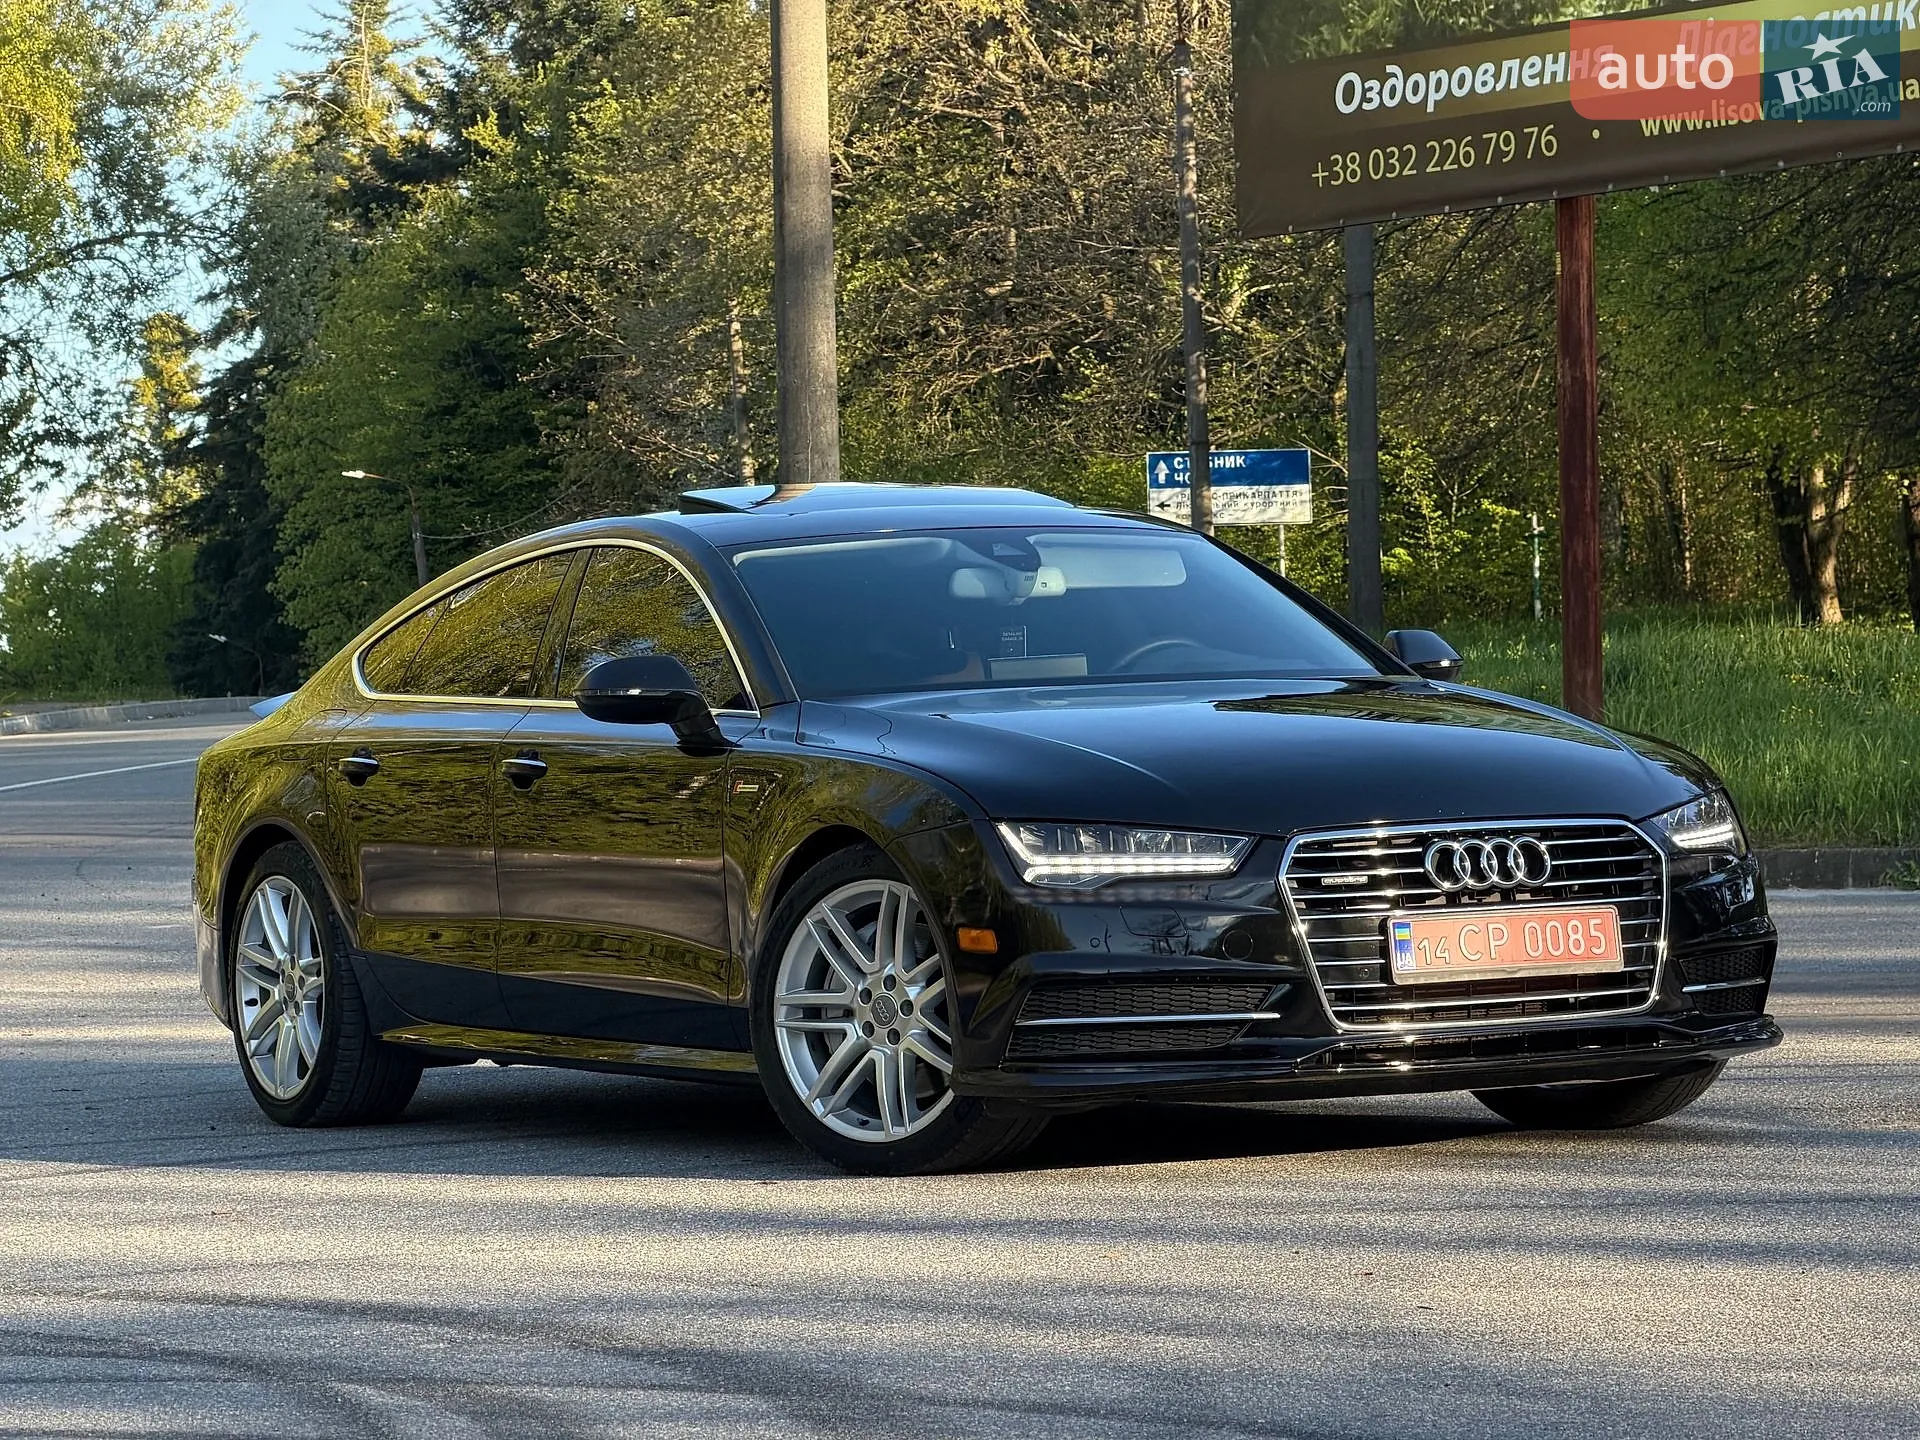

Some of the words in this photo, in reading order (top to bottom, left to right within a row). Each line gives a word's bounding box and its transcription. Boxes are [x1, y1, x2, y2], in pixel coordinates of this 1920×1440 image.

[1335, 44, 1614, 114] Оздоровлення
[1668, 0, 1920, 77] Діагностик
[1311, 151, 1361, 187] +38
[1368, 144, 1417, 180] 032
[1425, 136, 1475, 173] 226
[1482, 130, 1515, 165] 79
[1523, 124, 1558, 159] 76
[1174, 455, 1246, 469] СТНИК
[1396, 952, 1414, 966] UA
[1417, 937, 1450, 965] 14
[1459, 922, 1509, 960] CP
[1523, 917, 1608, 958] 0085
